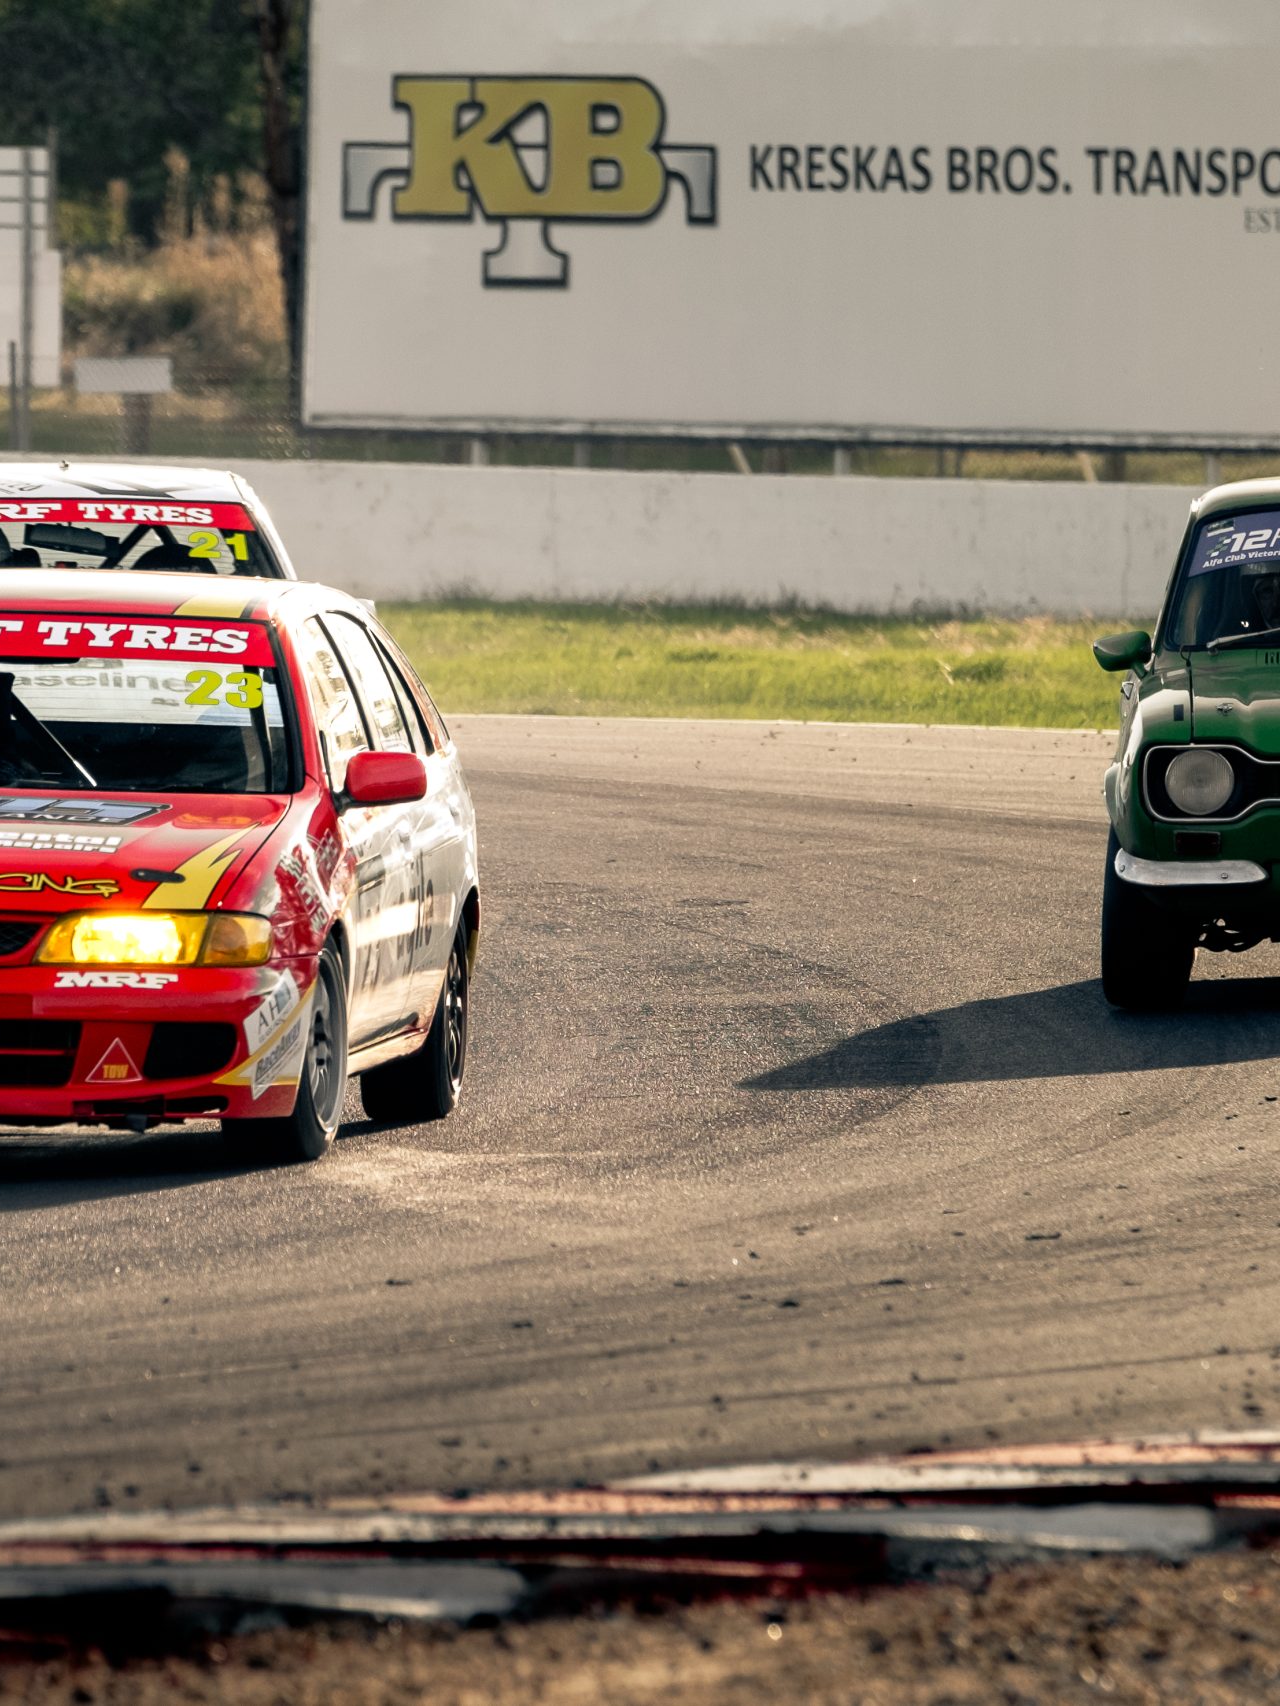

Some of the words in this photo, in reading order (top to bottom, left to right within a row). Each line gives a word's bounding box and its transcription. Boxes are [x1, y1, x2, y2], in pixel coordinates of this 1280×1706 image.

[747, 143, 933, 194] KRESKAS
[947, 147, 1072, 196] BROS.
[77, 504, 214, 525] TYRES
[188, 531, 249, 561] 21
[1202, 558, 1223, 568] Alfa
[1224, 553, 1246, 563] Club
[37, 620, 250, 654] TYRES
[184, 669, 264, 709] 23
[54, 972, 178, 988] MRF
[103, 1064, 129, 1079] TOW
